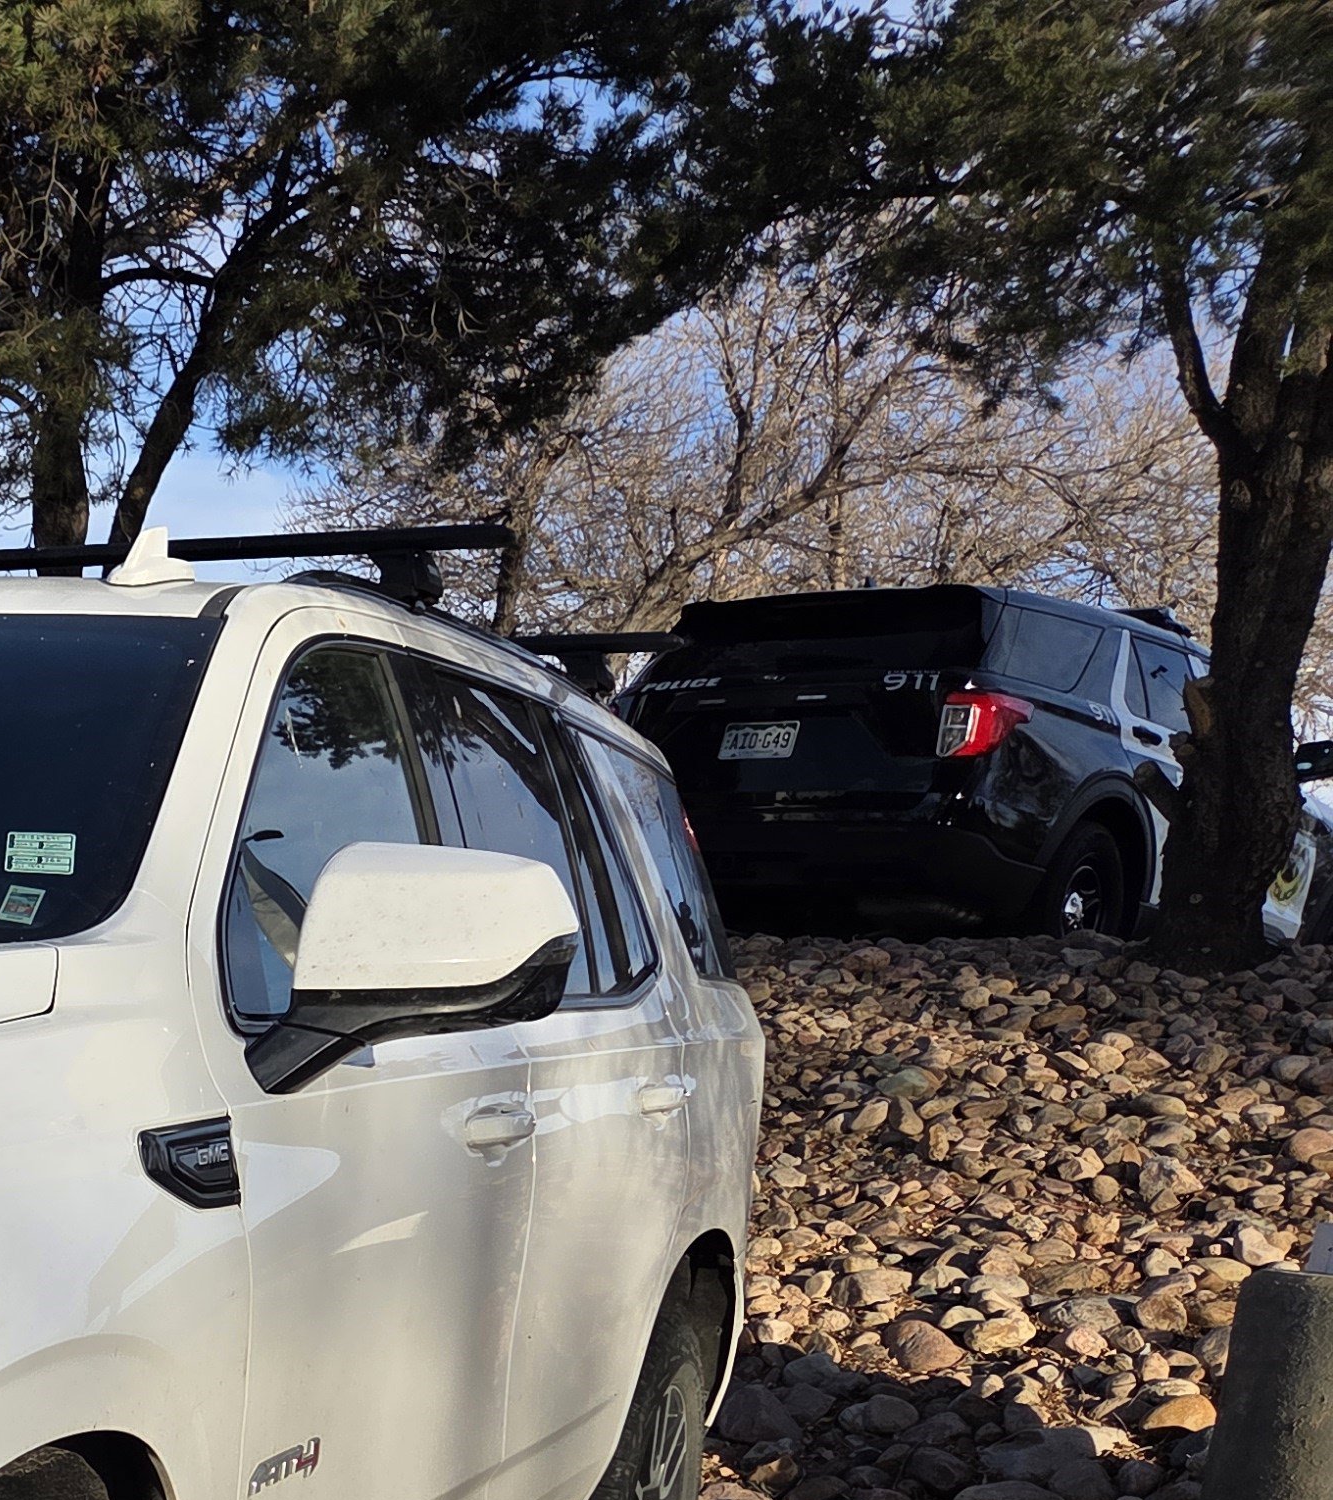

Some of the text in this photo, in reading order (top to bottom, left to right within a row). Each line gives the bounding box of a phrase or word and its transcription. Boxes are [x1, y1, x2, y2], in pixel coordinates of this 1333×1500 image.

[640, 677, 722, 693] POLICE
[883, 673, 940, 691] 911
[1088, 702, 1118, 726] 911
[197, 1141, 230, 1166] GMC
